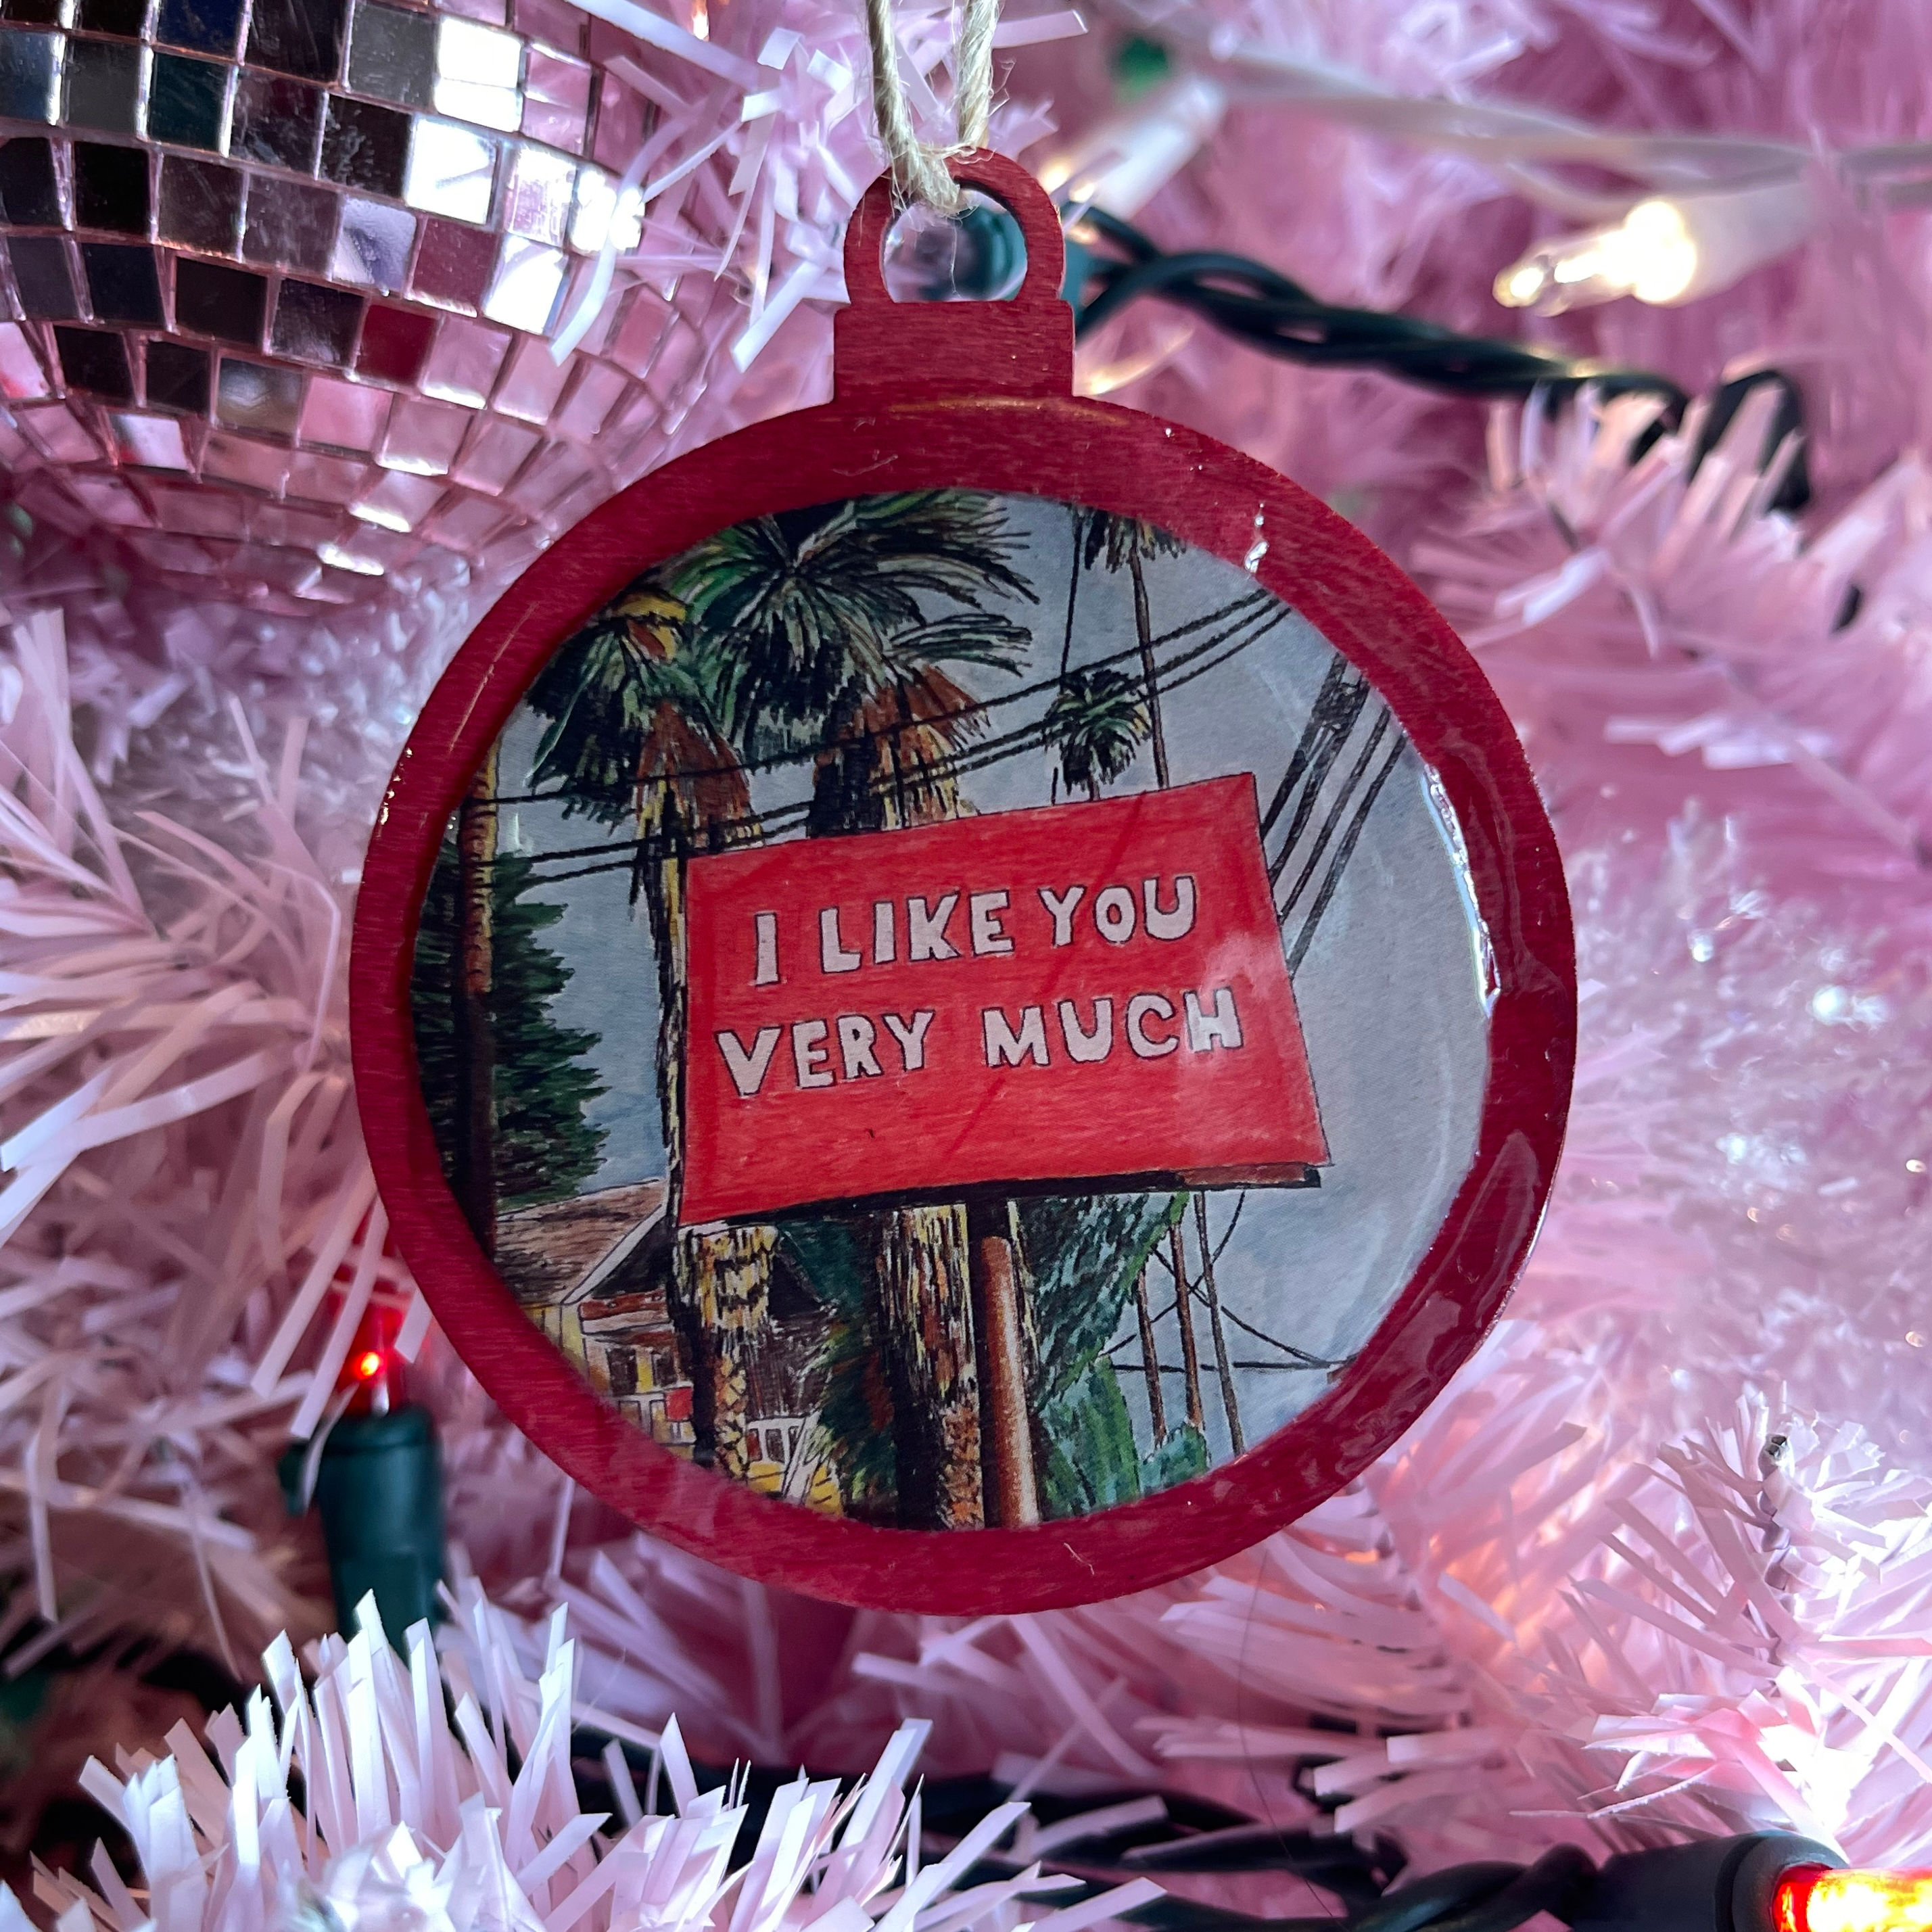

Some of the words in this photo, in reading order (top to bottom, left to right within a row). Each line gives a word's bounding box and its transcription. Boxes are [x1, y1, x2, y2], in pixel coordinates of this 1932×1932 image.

[754, 913, 780, 985] I
[820, 891, 1014, 973] LIKE
[1040, 876, 1196, 949] YOU
[716, 1010, 935, 1099] VERY
[983, 988, 1244, 1068] MUCH
